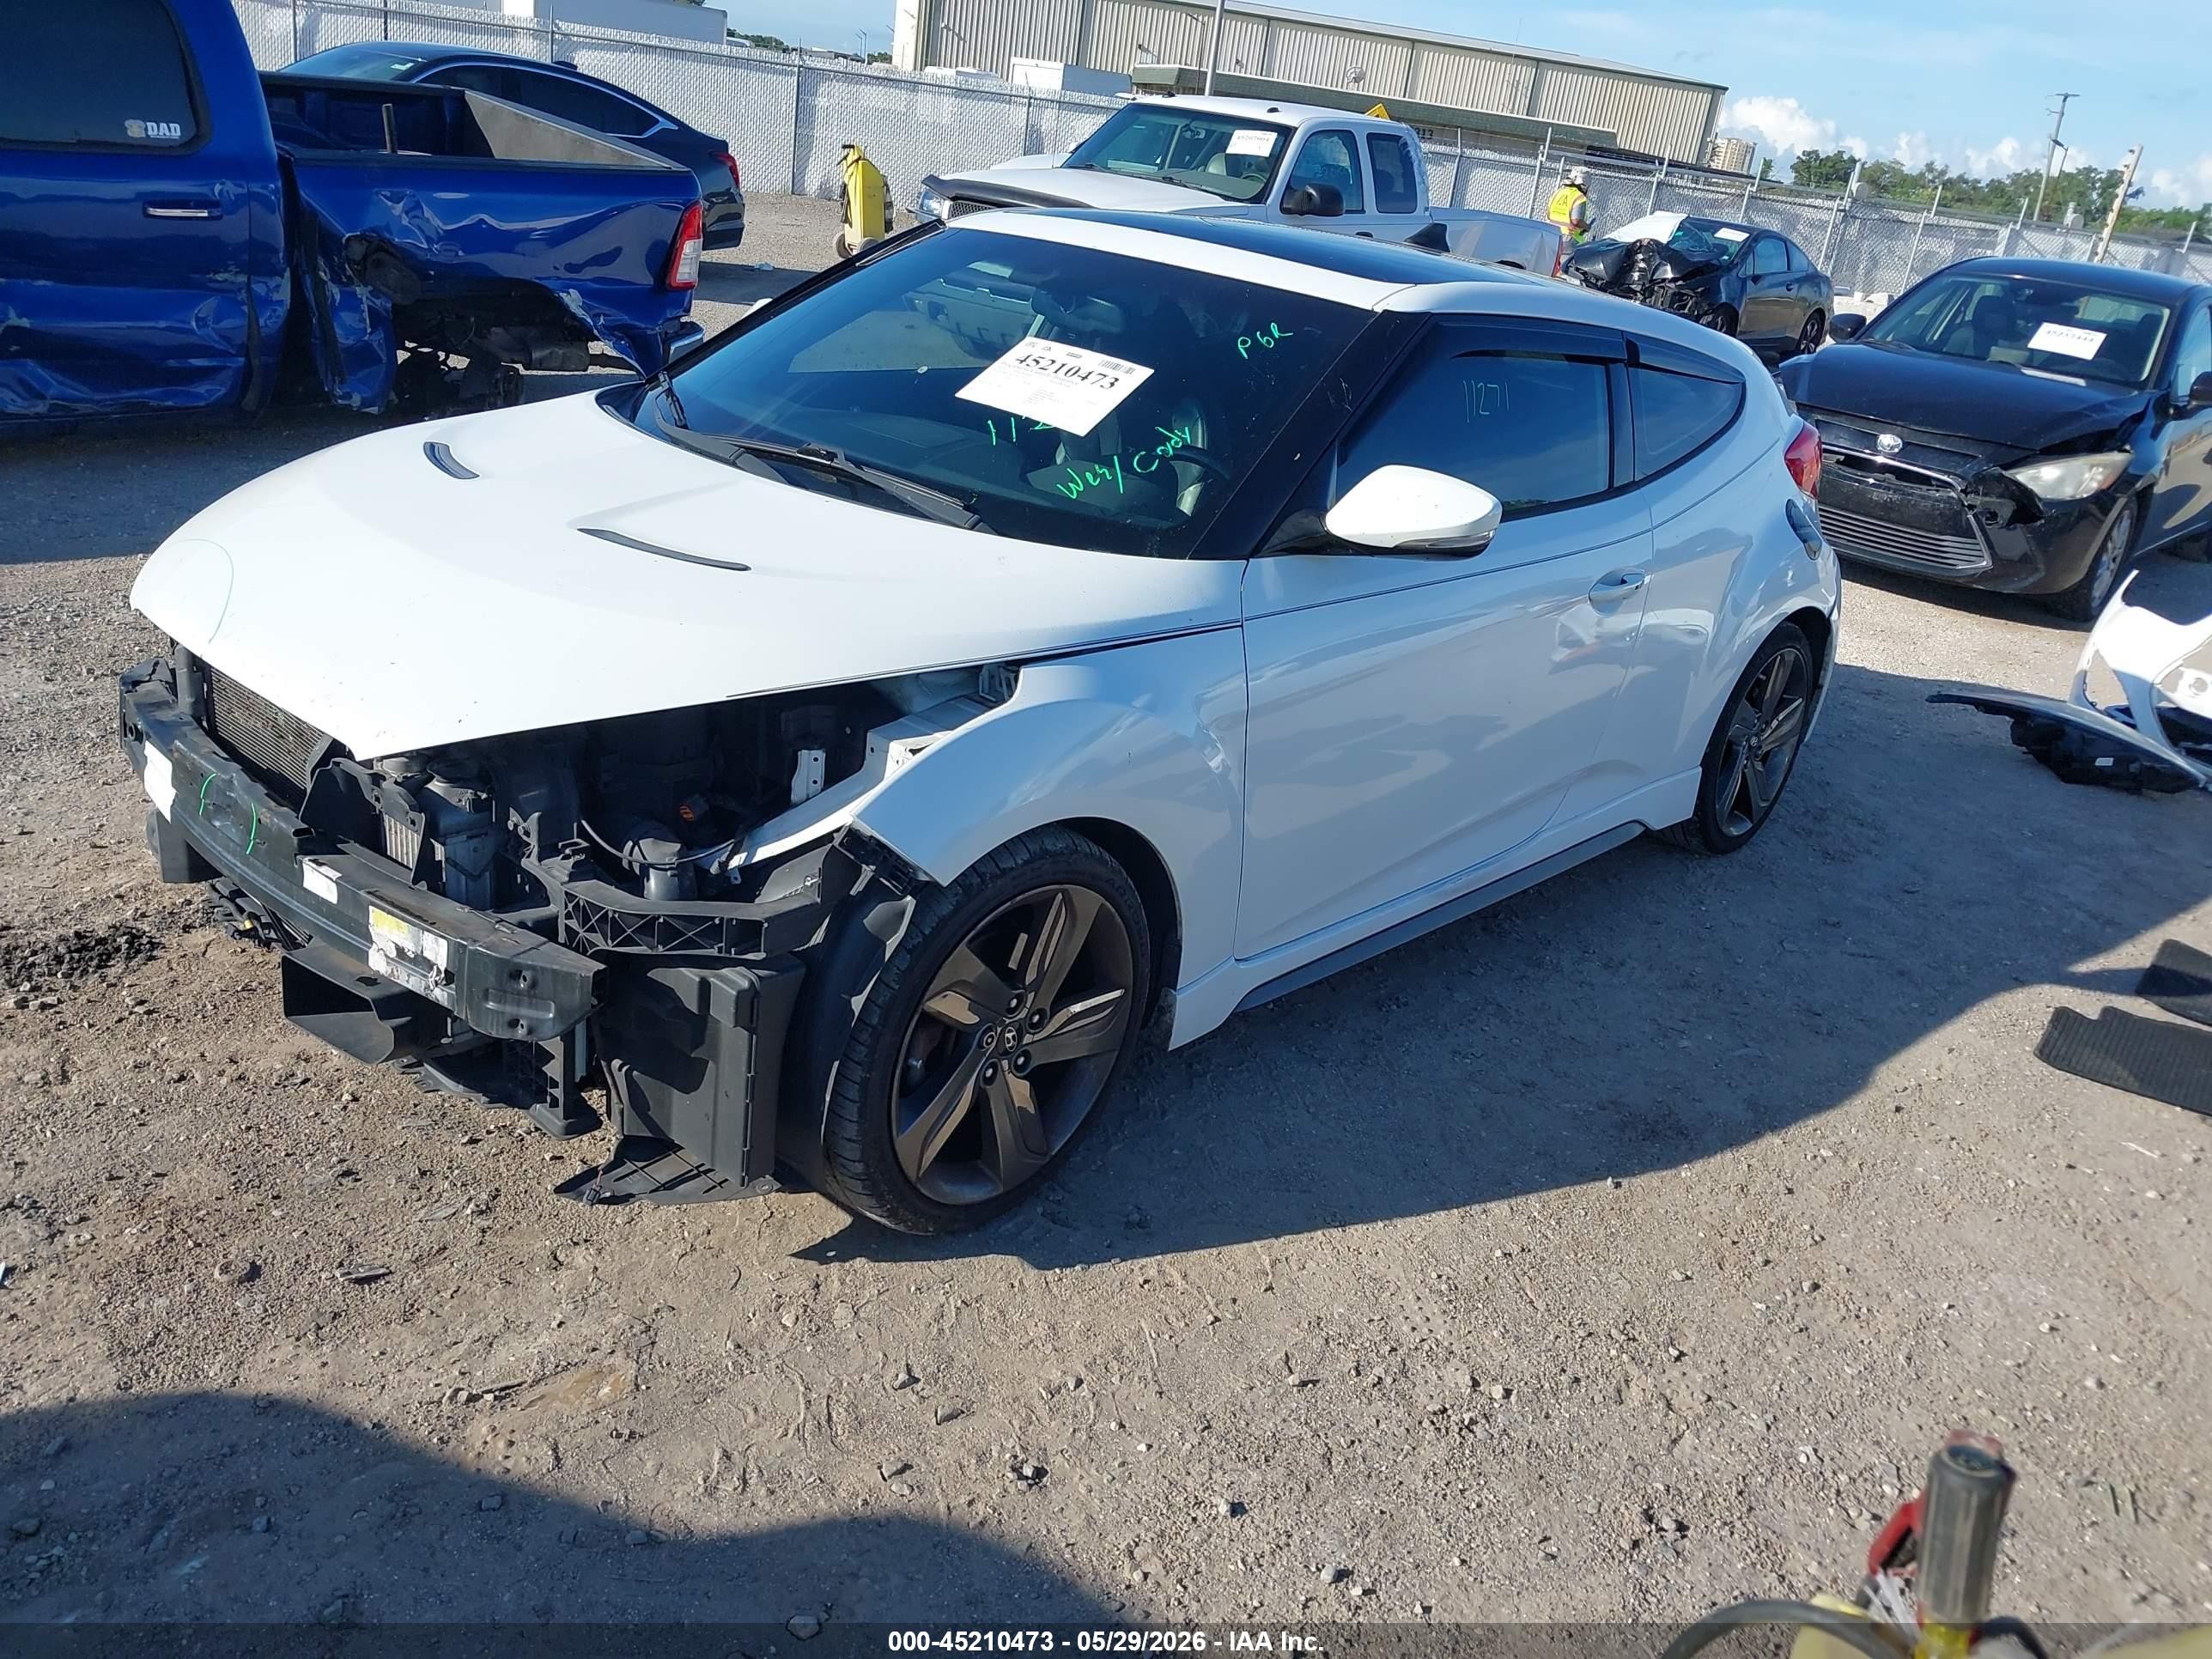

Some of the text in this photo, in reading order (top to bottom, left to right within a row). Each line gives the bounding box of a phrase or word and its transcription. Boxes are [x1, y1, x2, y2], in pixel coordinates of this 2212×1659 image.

[146, 122, 181, 137] DAD
[1015, 353, 1120, 390] 45210473
[1462, 380, 1510, 423] 11271
